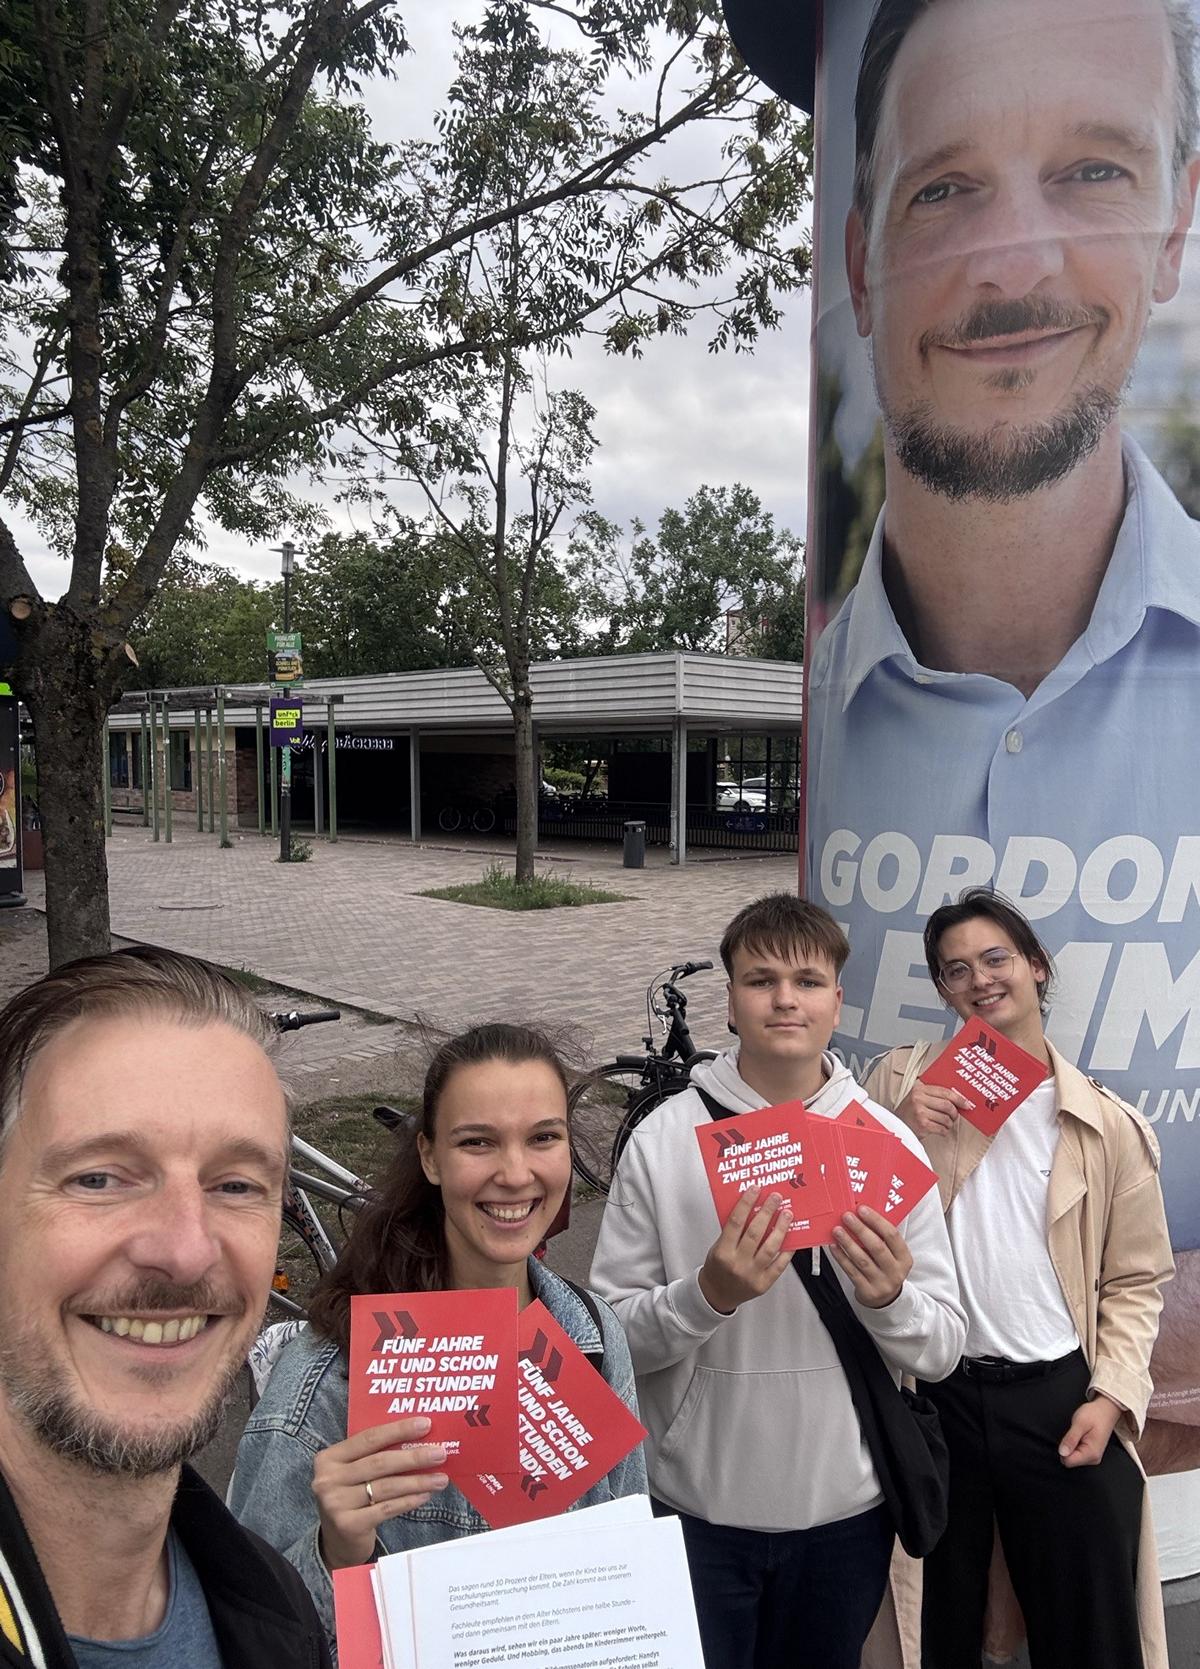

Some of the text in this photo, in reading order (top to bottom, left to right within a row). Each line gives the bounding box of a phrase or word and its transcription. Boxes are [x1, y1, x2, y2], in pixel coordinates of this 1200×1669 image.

[275, 719, 295, 727] berlin
[954, 1054, 977, 1073] ZWEI
[974, 1070, 1012, 1101] STUNDEN
[958, 1047, 1020, 1096] ALT UND SCHON
[972, 1045, 1020, 1084] FÜNF JAHRE
[956, 1069, 972, 1080] AM
[968, 1078, 998, 1103] HANDY.
[1136, 1088, 1200, 1123] UN
[718, 1142, 802, 1173] ALT UND SCHON
[724, 1132, 789, 1158] FÜNF JAHRE
[722, 1154, 803, 1184] ZWEI STUNDEN
[757, 1169, 796, 1188] HANDY.
[381, 1336, 484, 1354] FÜNF JAHRE
[366, 1354, 498, 1374] ALT UND SCHON
[368, 1374, 496, 1394] ZWEI STUNDEN
[387, 1395, 480, 1414] AM HANDY.
[518, 1358, 594, 1446] FÜNF JAHRE
[518, 1386, 590, 1470] UND SCHON
[519, 1441, 548, 1482] NDY.
[448, 1585, 460, 1593] Das
[461, 1583, 479, 1592] sagen
[504, 1576, 527, 1584] Prozent
[552, 1580, 562, 1588] Die
[563, 1578, 576, 1586] Zahl
[576, 1576, 596, 1584] kommt
[608, 1572, 632, 1580] unserem
[451, 1620, 480, 1630] Fachleute
[522, 1612, 536, 1620] dem
[536, 1610, 550, 1619] Alter
[552, 1606, 581, 1616] höchstens
[582, 1604, 594, 1612] eine
[595, 1602, 610, 1610] halbe
[612, 1599, 631, 1608] Stunde
[452, 1632, 464, 1640] und
[465, 1630, 480, 1638] dann
[482, 1625, 516, 1636] gemeinsam
[529, 1621, 541, 1629] den
[454, 1651, 468, 1659] Was
[468, 1648, 490, 1656] daraus
[491, 1646, 507, 1654] wird,
[508, 1642, 526, 1650] sehen
[528, 1640, 538, 1648] wir
[538, 1638, 548, 1646] ein
[549, 1636, 564, 1646] paar
[564, 1634, 580, 1642] Jahre
[604, 1628, 626, 1636] weniger
[454, 1630, 668, 1668] weniger Geduld. Und Mobbing, das abends im Kinderzimmer weitergeht.
[638, 1650, 660, 1660] Handys
[642, 1660, 658, 1668] selbst
